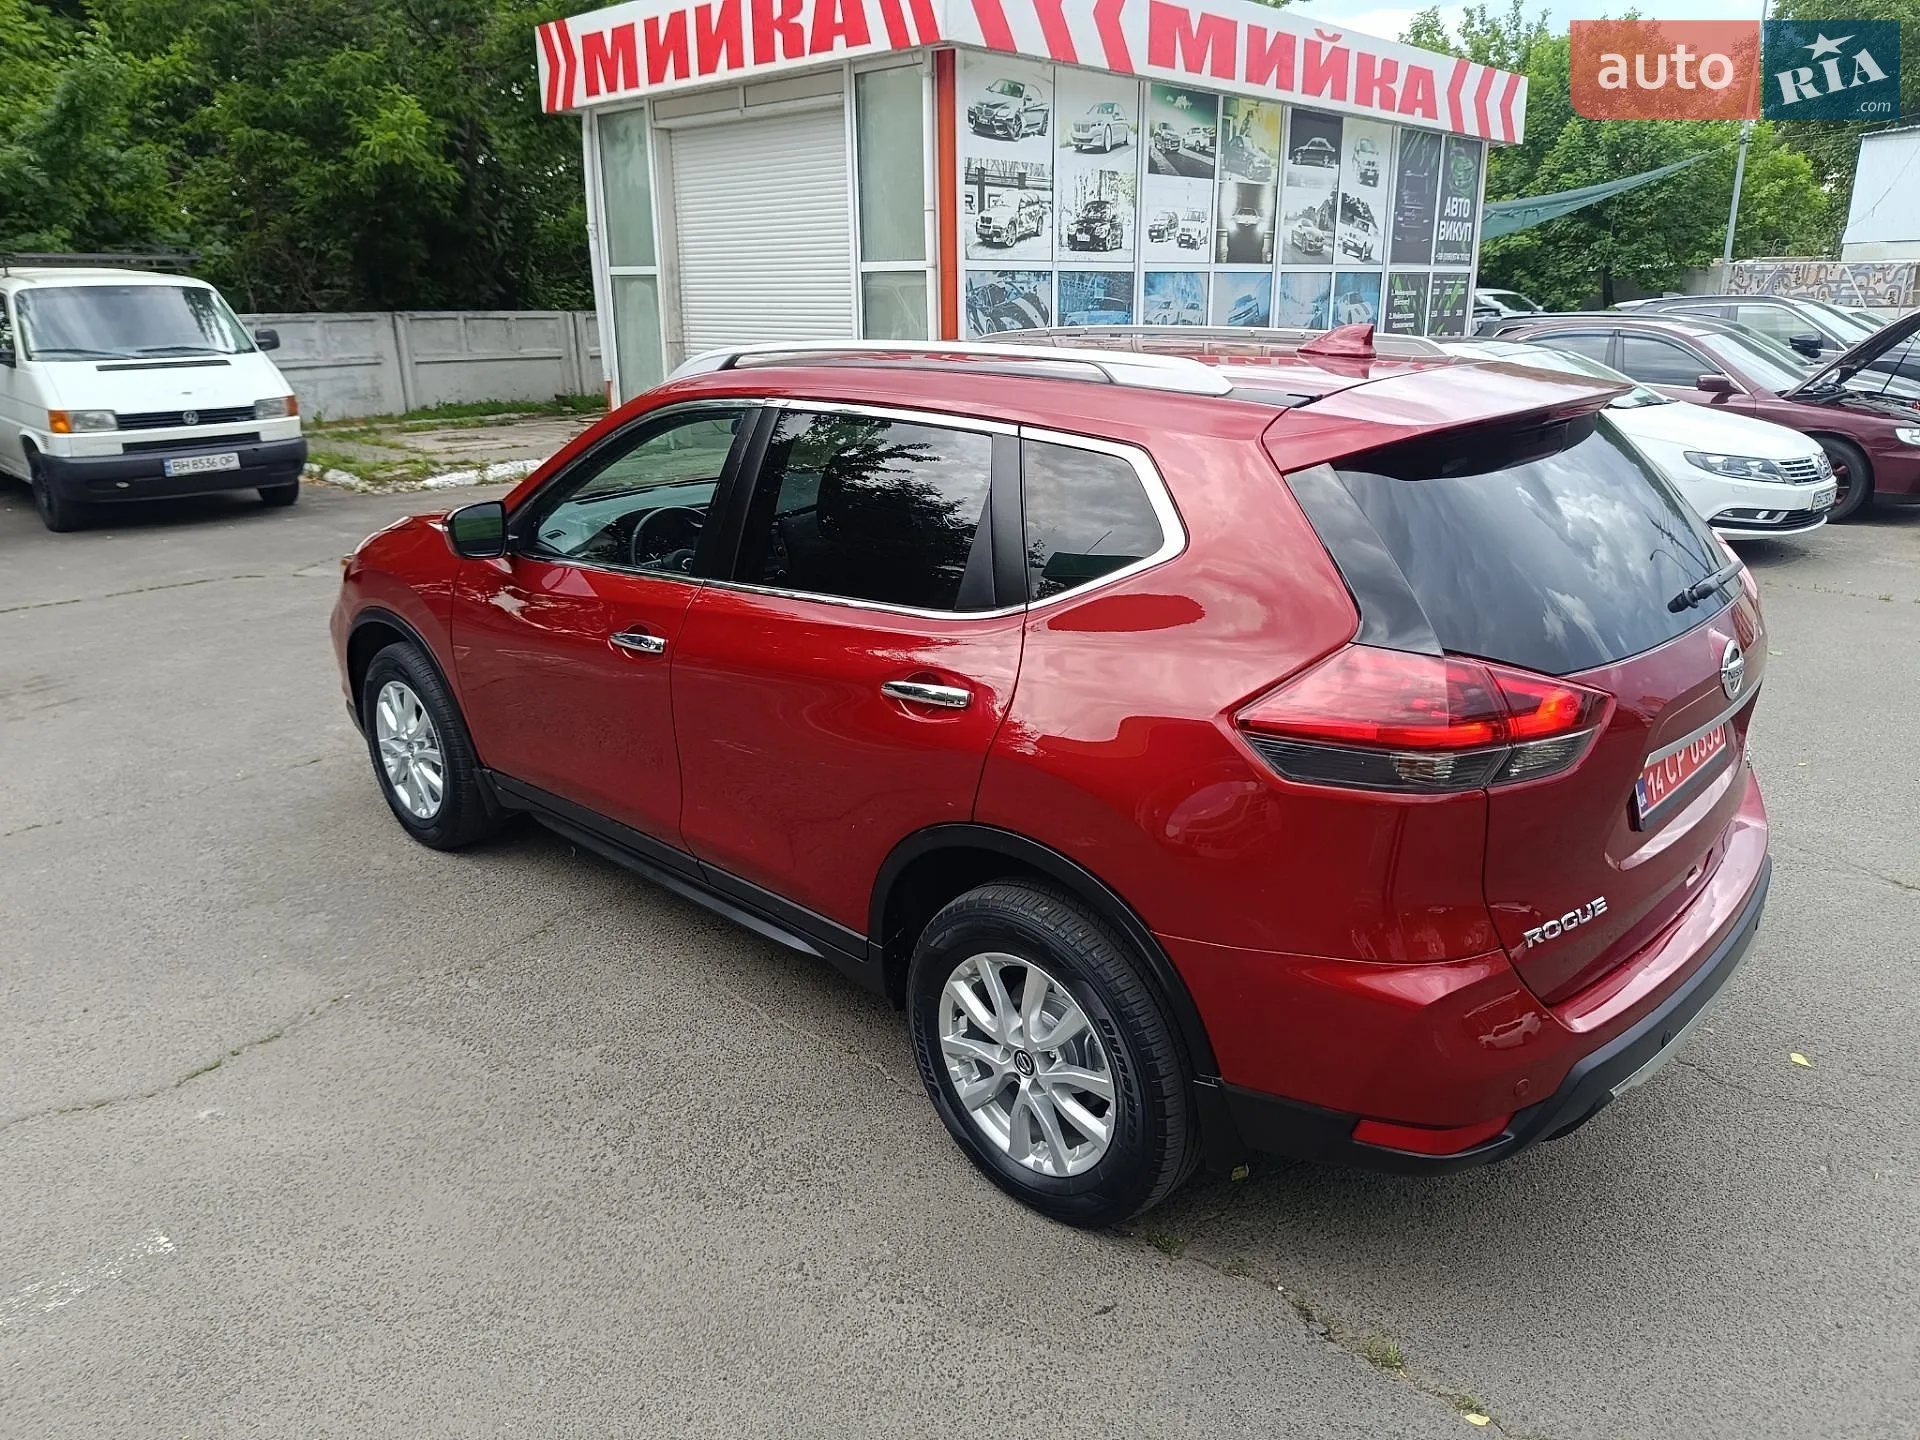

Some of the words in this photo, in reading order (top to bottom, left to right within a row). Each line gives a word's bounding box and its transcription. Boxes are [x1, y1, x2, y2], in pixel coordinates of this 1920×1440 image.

[1148, 0, 1439, 120] МИЙКА
[1444, 196, 1471, 218] АВТО
[1438, 220, 1473, 242] ВИКУП
[1647, 766, 1665, 801] 14
[1522, 895, 1609, 950] ROGUE
